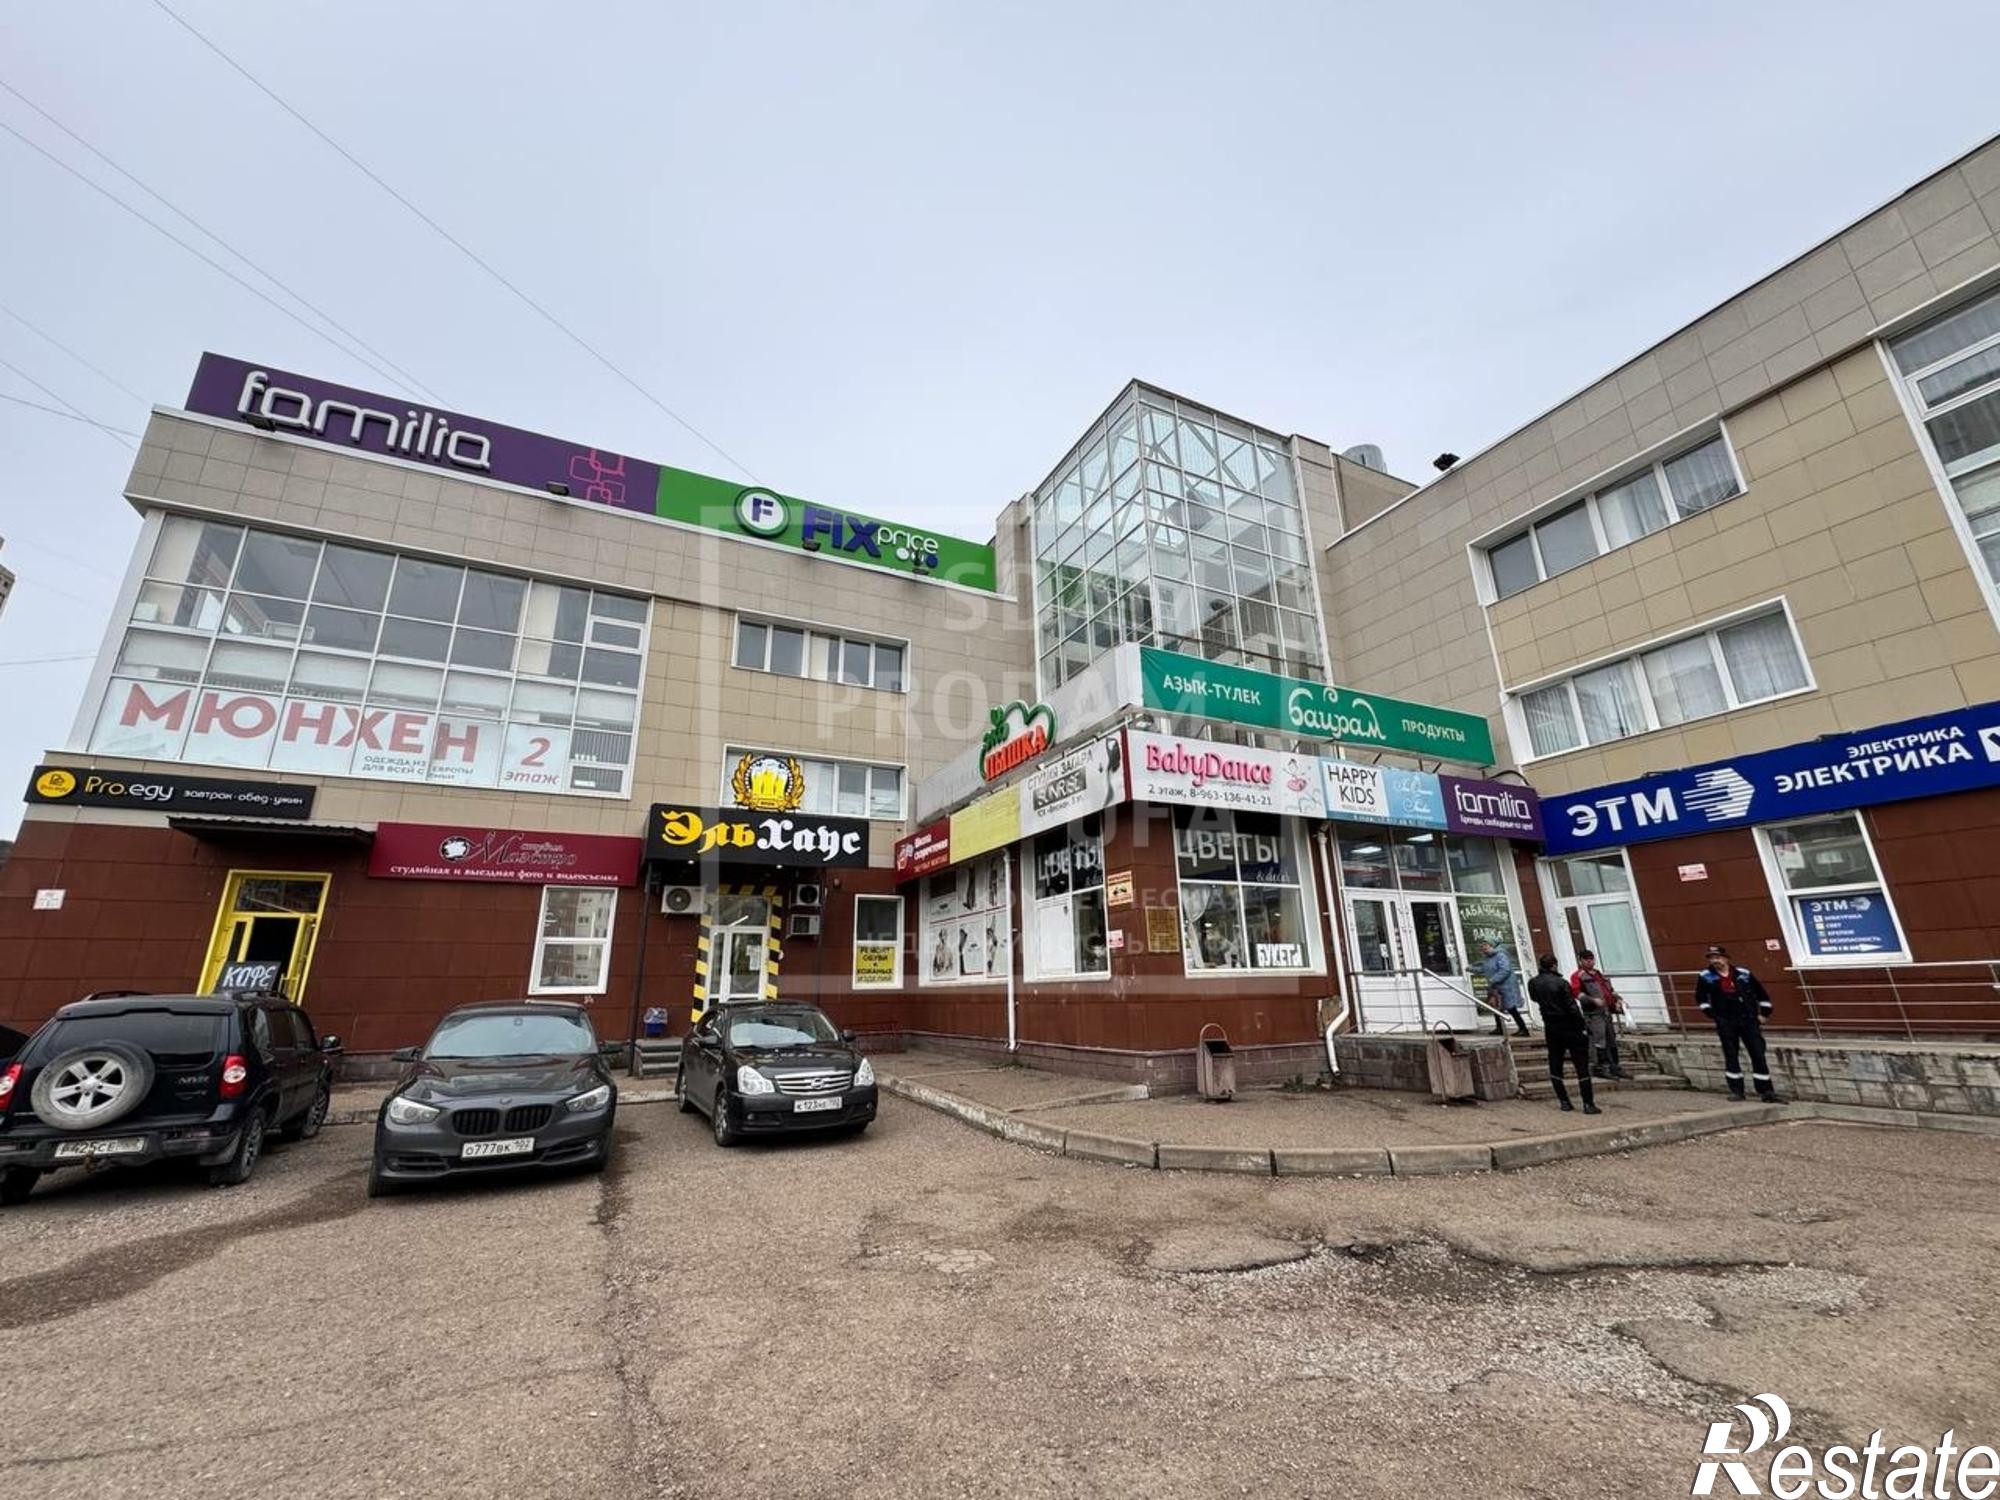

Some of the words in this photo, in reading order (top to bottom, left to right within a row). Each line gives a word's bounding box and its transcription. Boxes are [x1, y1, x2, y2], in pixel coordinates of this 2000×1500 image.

[237, 370, 491, 469] familia
[801, 503, 881, 558] FIX
[876, 526, 939, 554] price
[118, 682, 480, 764] МЮНХЕН
[1402, 718, 1466, 742] ПРОДУКТЫ
[520, 736, 551, 768] 2
[1847, 726, 1966, 758] ЭЛЕКТРИКА
[363, 755, 411, 767] ОДЕЖДА
[431, 765, 474, 775] ЕВРОПЫ
[504, 770, 560, 785] этаж
[1145, 741, 1272, 788] BabyDance
[1327, 764, 1377, 787] HAPPY
[85, 776, 174, 801] Pro.egy
[1148, 784, 1155, 794] 2
[1339, 785, 1376, 806] KIDS
[1454, 784, 1532, 819] familia
[1566, 786, 1678, 837] ЭТМ
[1774, 741, 1974, 793] ЭЛЕКТРИКА
[1177, 829, 1279, 868] ЦВЕТЫ
[1810, 900, 1848, 912] ЭТМ
